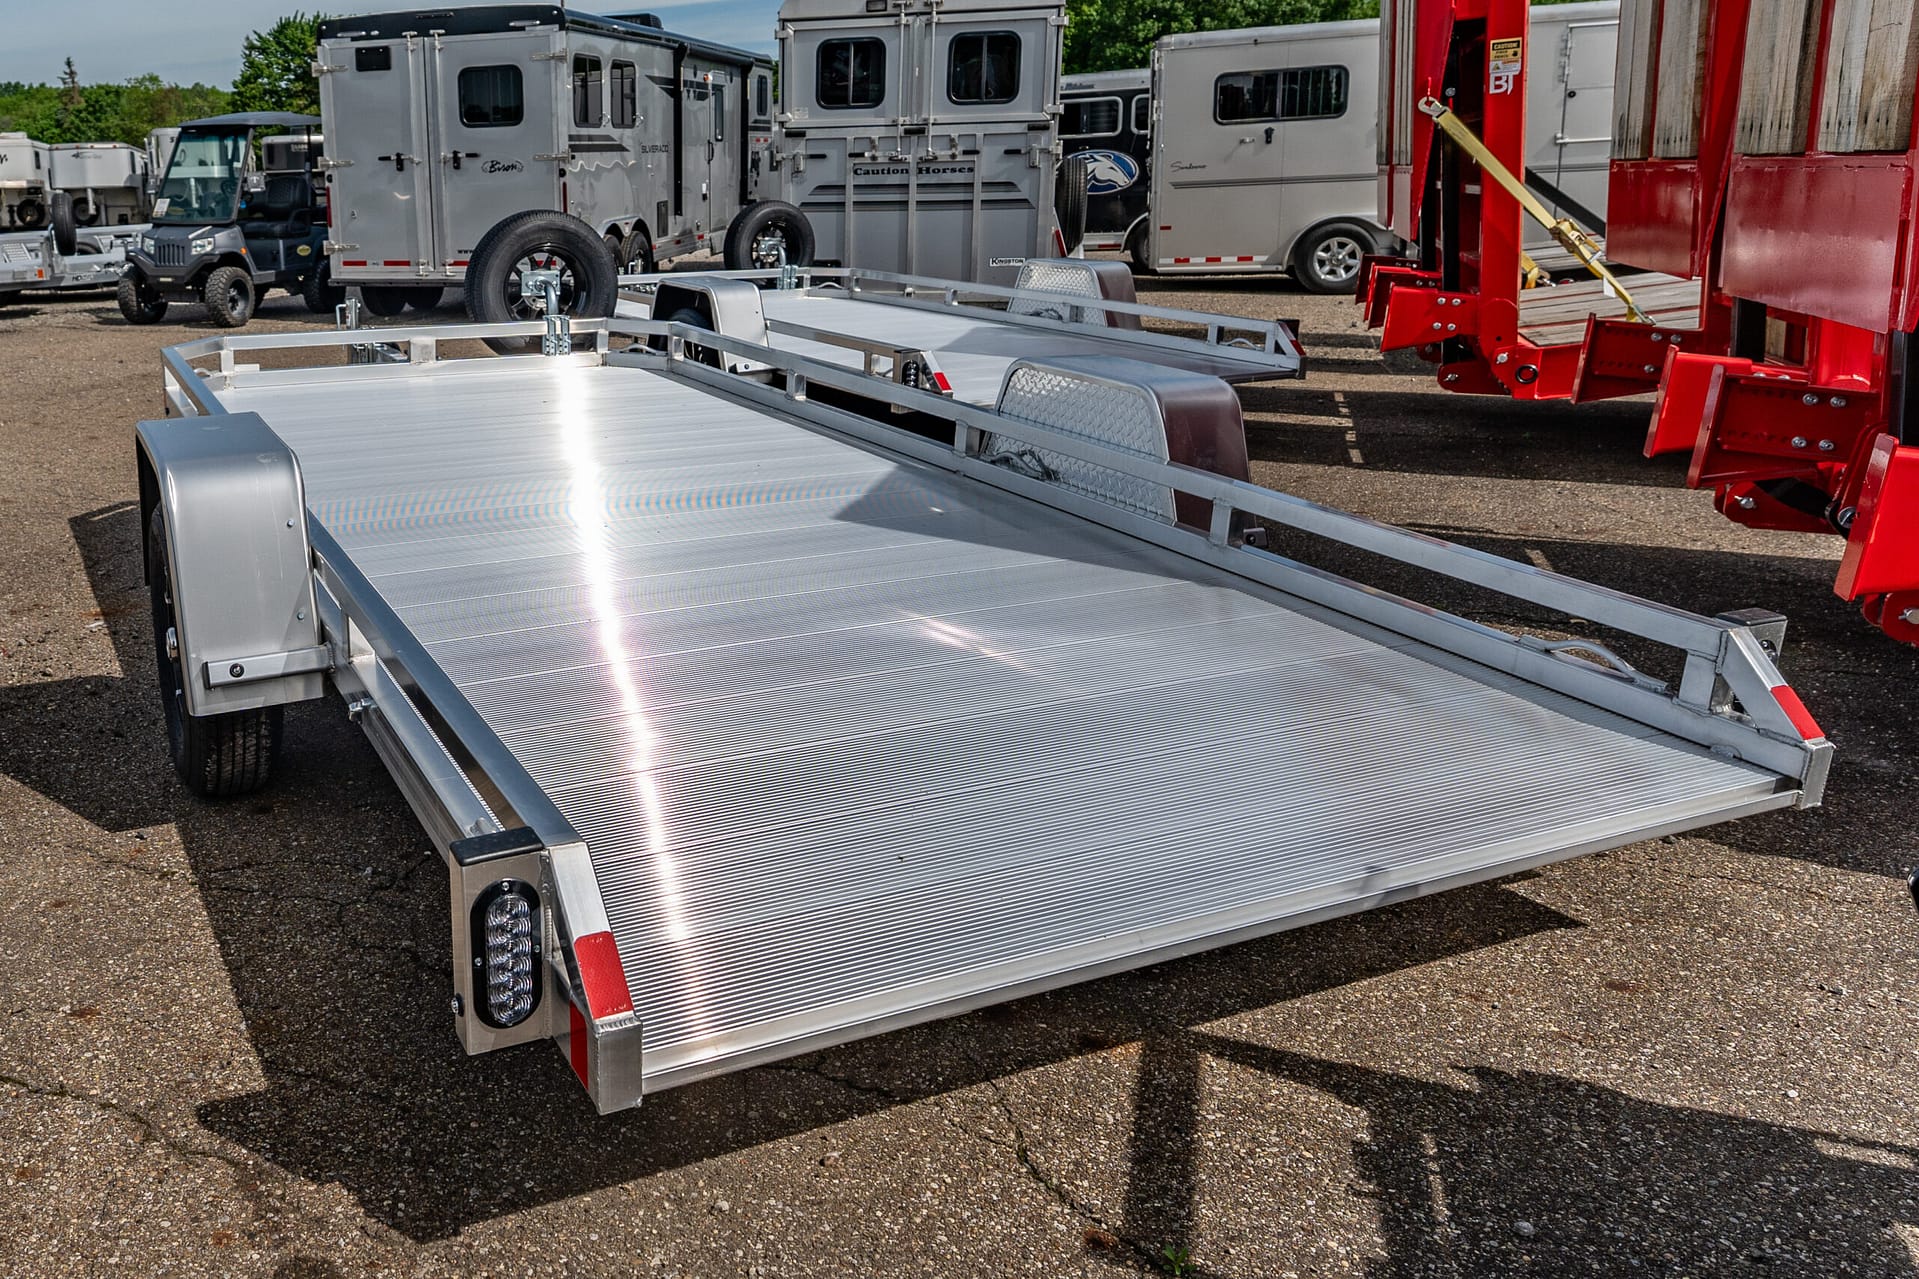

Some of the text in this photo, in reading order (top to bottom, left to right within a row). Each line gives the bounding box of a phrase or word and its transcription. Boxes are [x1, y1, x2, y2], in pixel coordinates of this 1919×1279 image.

[1489, 72, 1520, 95] BT
[488, 160, 518, 173] Bison
[853, 166, 975, 176] Caution Horses
